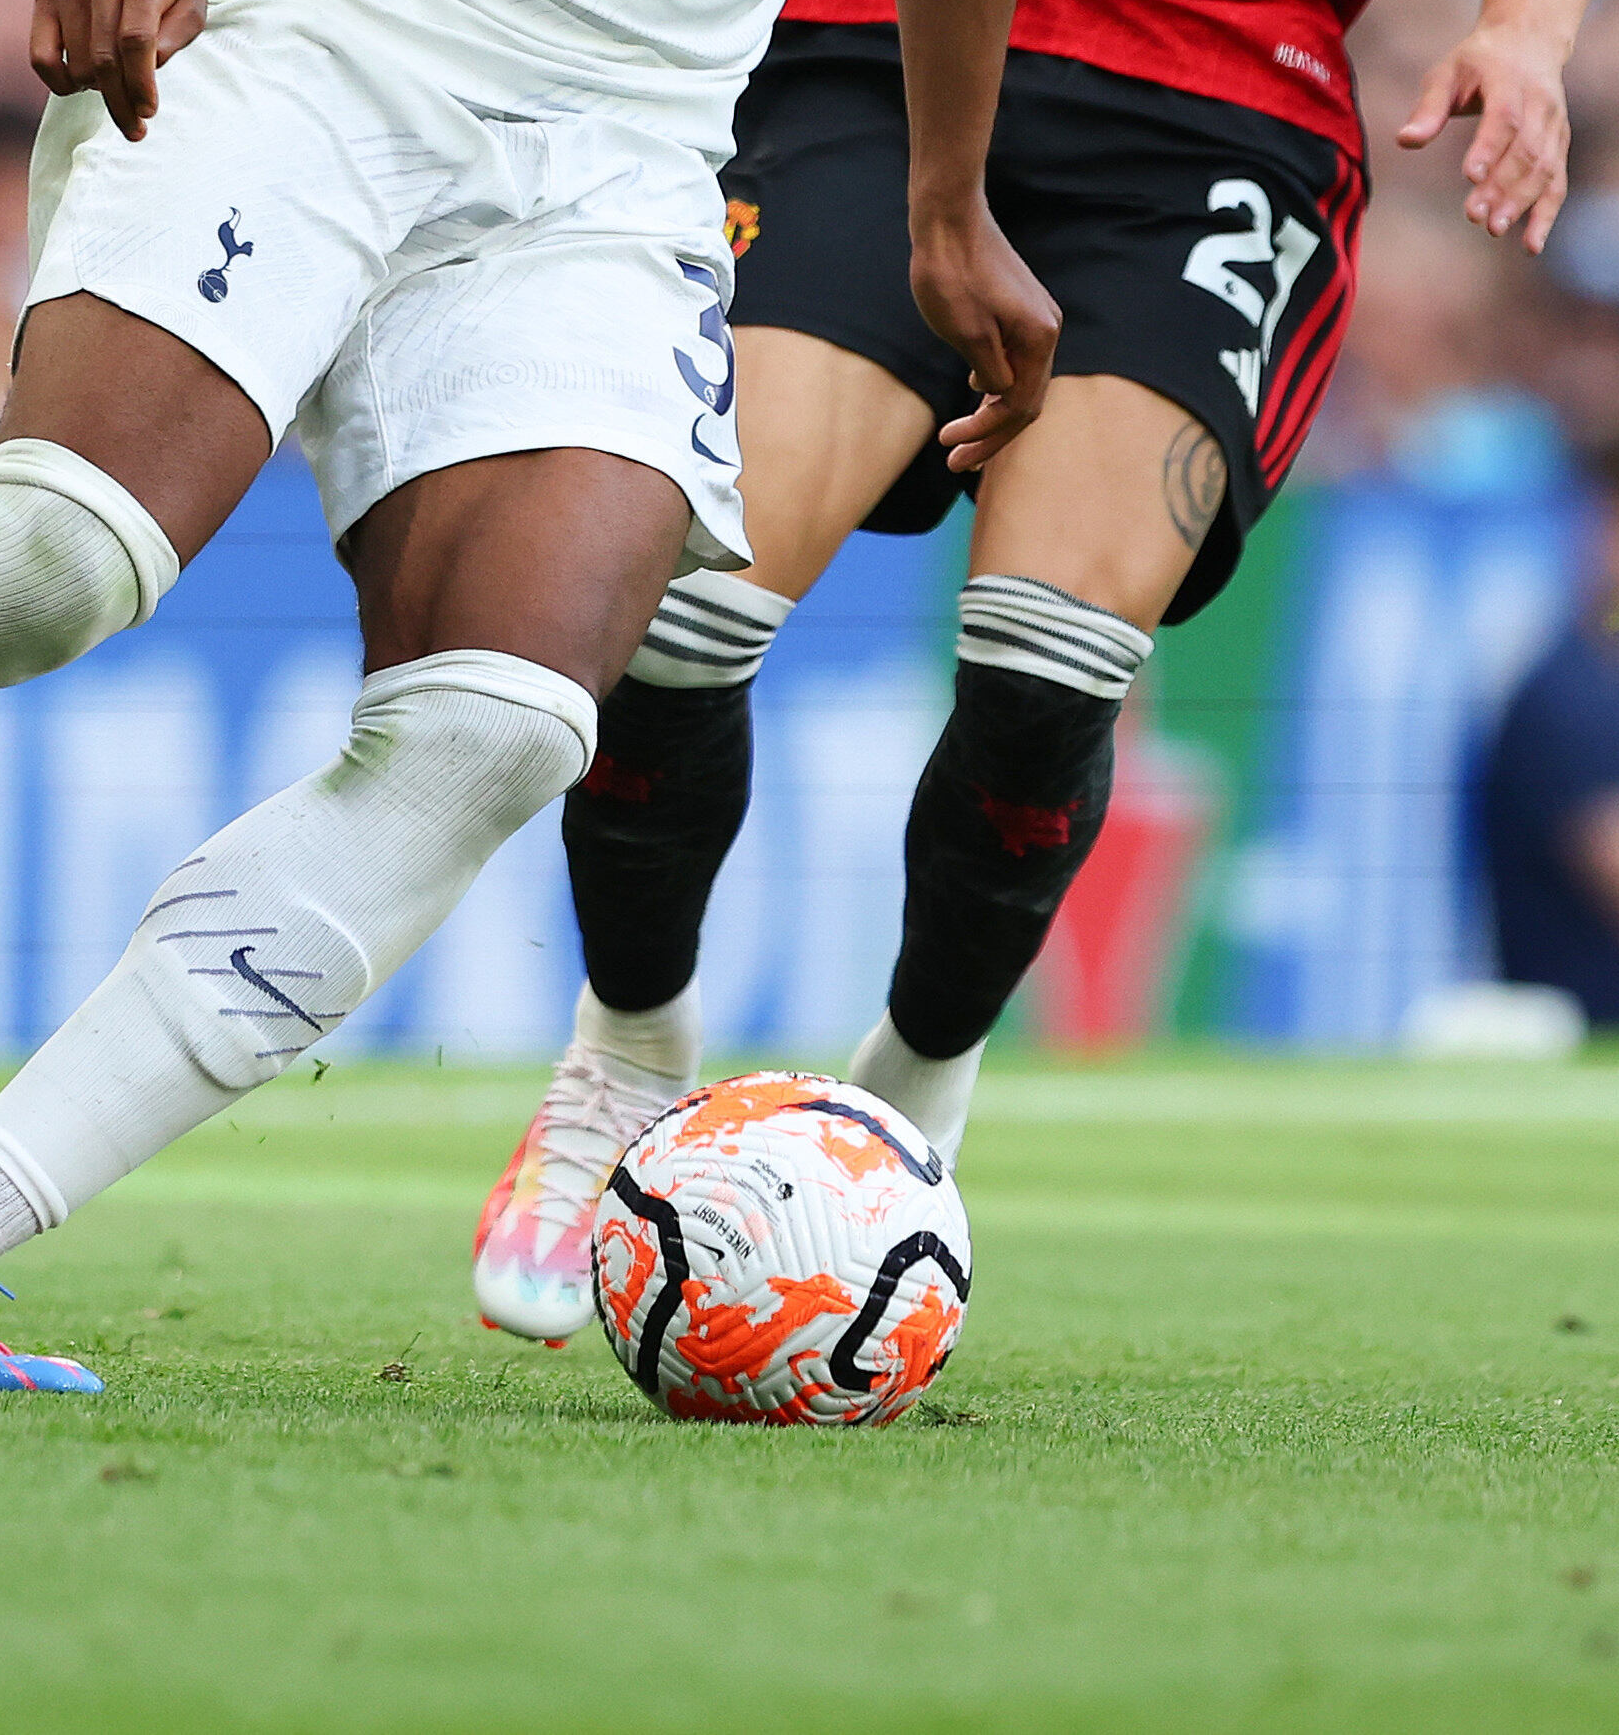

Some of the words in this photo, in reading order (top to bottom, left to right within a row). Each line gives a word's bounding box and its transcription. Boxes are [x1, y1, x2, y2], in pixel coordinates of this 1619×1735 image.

[1181, 178, 1322, 366] 21
[692, 1201, 731, 1237] FLIGHT
[725, 1228, 756, 1260] NIKE
